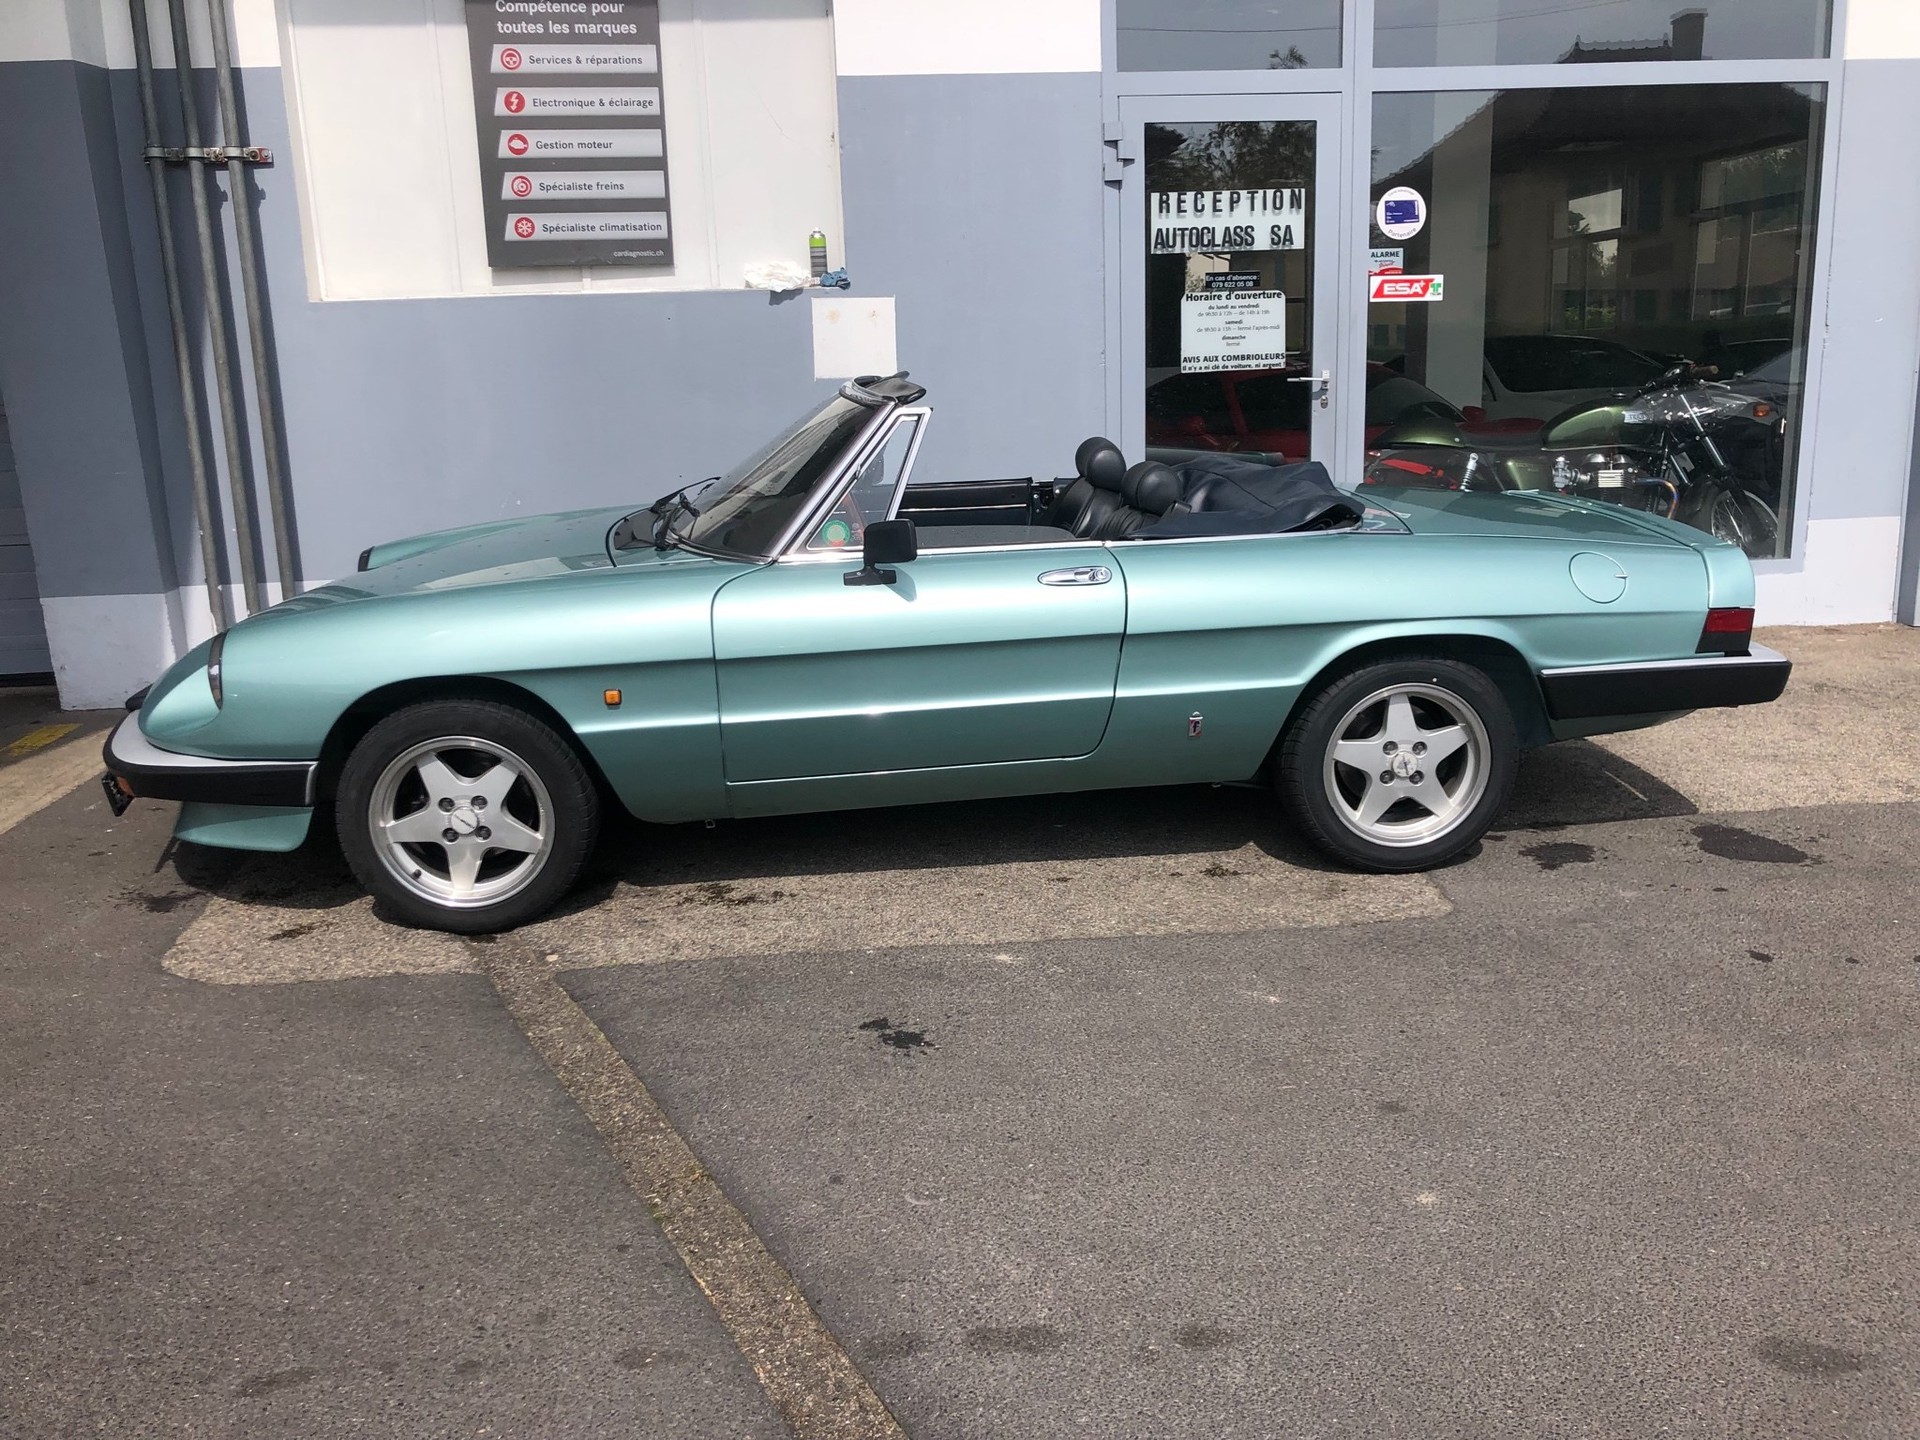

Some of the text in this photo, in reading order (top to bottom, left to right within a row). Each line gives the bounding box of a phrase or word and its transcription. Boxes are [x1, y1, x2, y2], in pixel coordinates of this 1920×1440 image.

[495, 0, 625, 16] Compétence pour
[497, 20, 638, 37] toutes les marques
[528, 54, 643, 67] Services & réparations
[532, 97, 654, 109] Electronique & éclairage
[535, 140, 613, 150] Gestion moteur
[538, 181, 625, 193] Spécialiste freins
[1158, 188, 1303, 214] RECEPTION
[542, 222, 662, 234] Spécialiste climatisation
[1154, 224, 1294, 249] AUTOCLASS SA
[1185, 290, 1283, 301] Horaire d'ouverture
[1182, 355, 1201, 363] AVIS
[1221, 352, 1285, 362] COMBRIOLEURS
